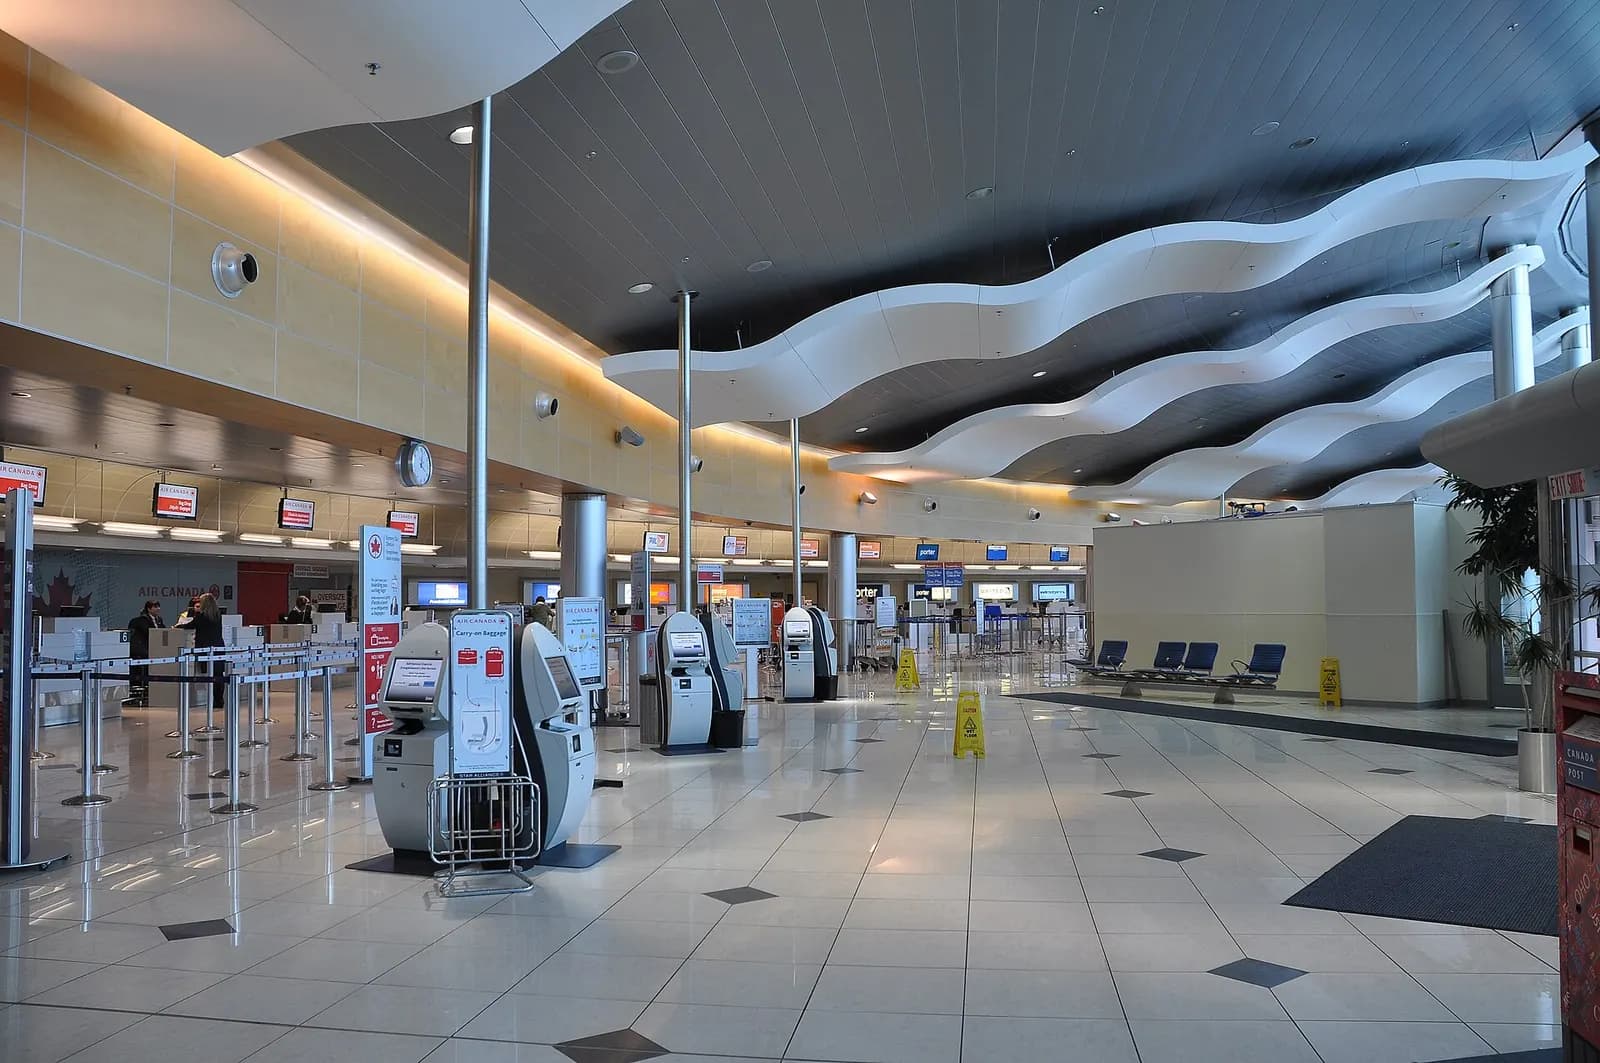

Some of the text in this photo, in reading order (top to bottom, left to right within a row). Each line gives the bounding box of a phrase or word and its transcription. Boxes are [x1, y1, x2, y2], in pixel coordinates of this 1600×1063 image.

[8, 467, 35, 476] CANADA
[919, 549, 936, 557] porter
[138, 586, 159, 597] AIR
[318, 592, 346, 601] OVERSIZE
[855, 586, 879, 598] orter
[122, 632, 128, 642] 6
[1567, 748, 1594, 763] CANADA
[1568, 767, 1584, 781] POST
